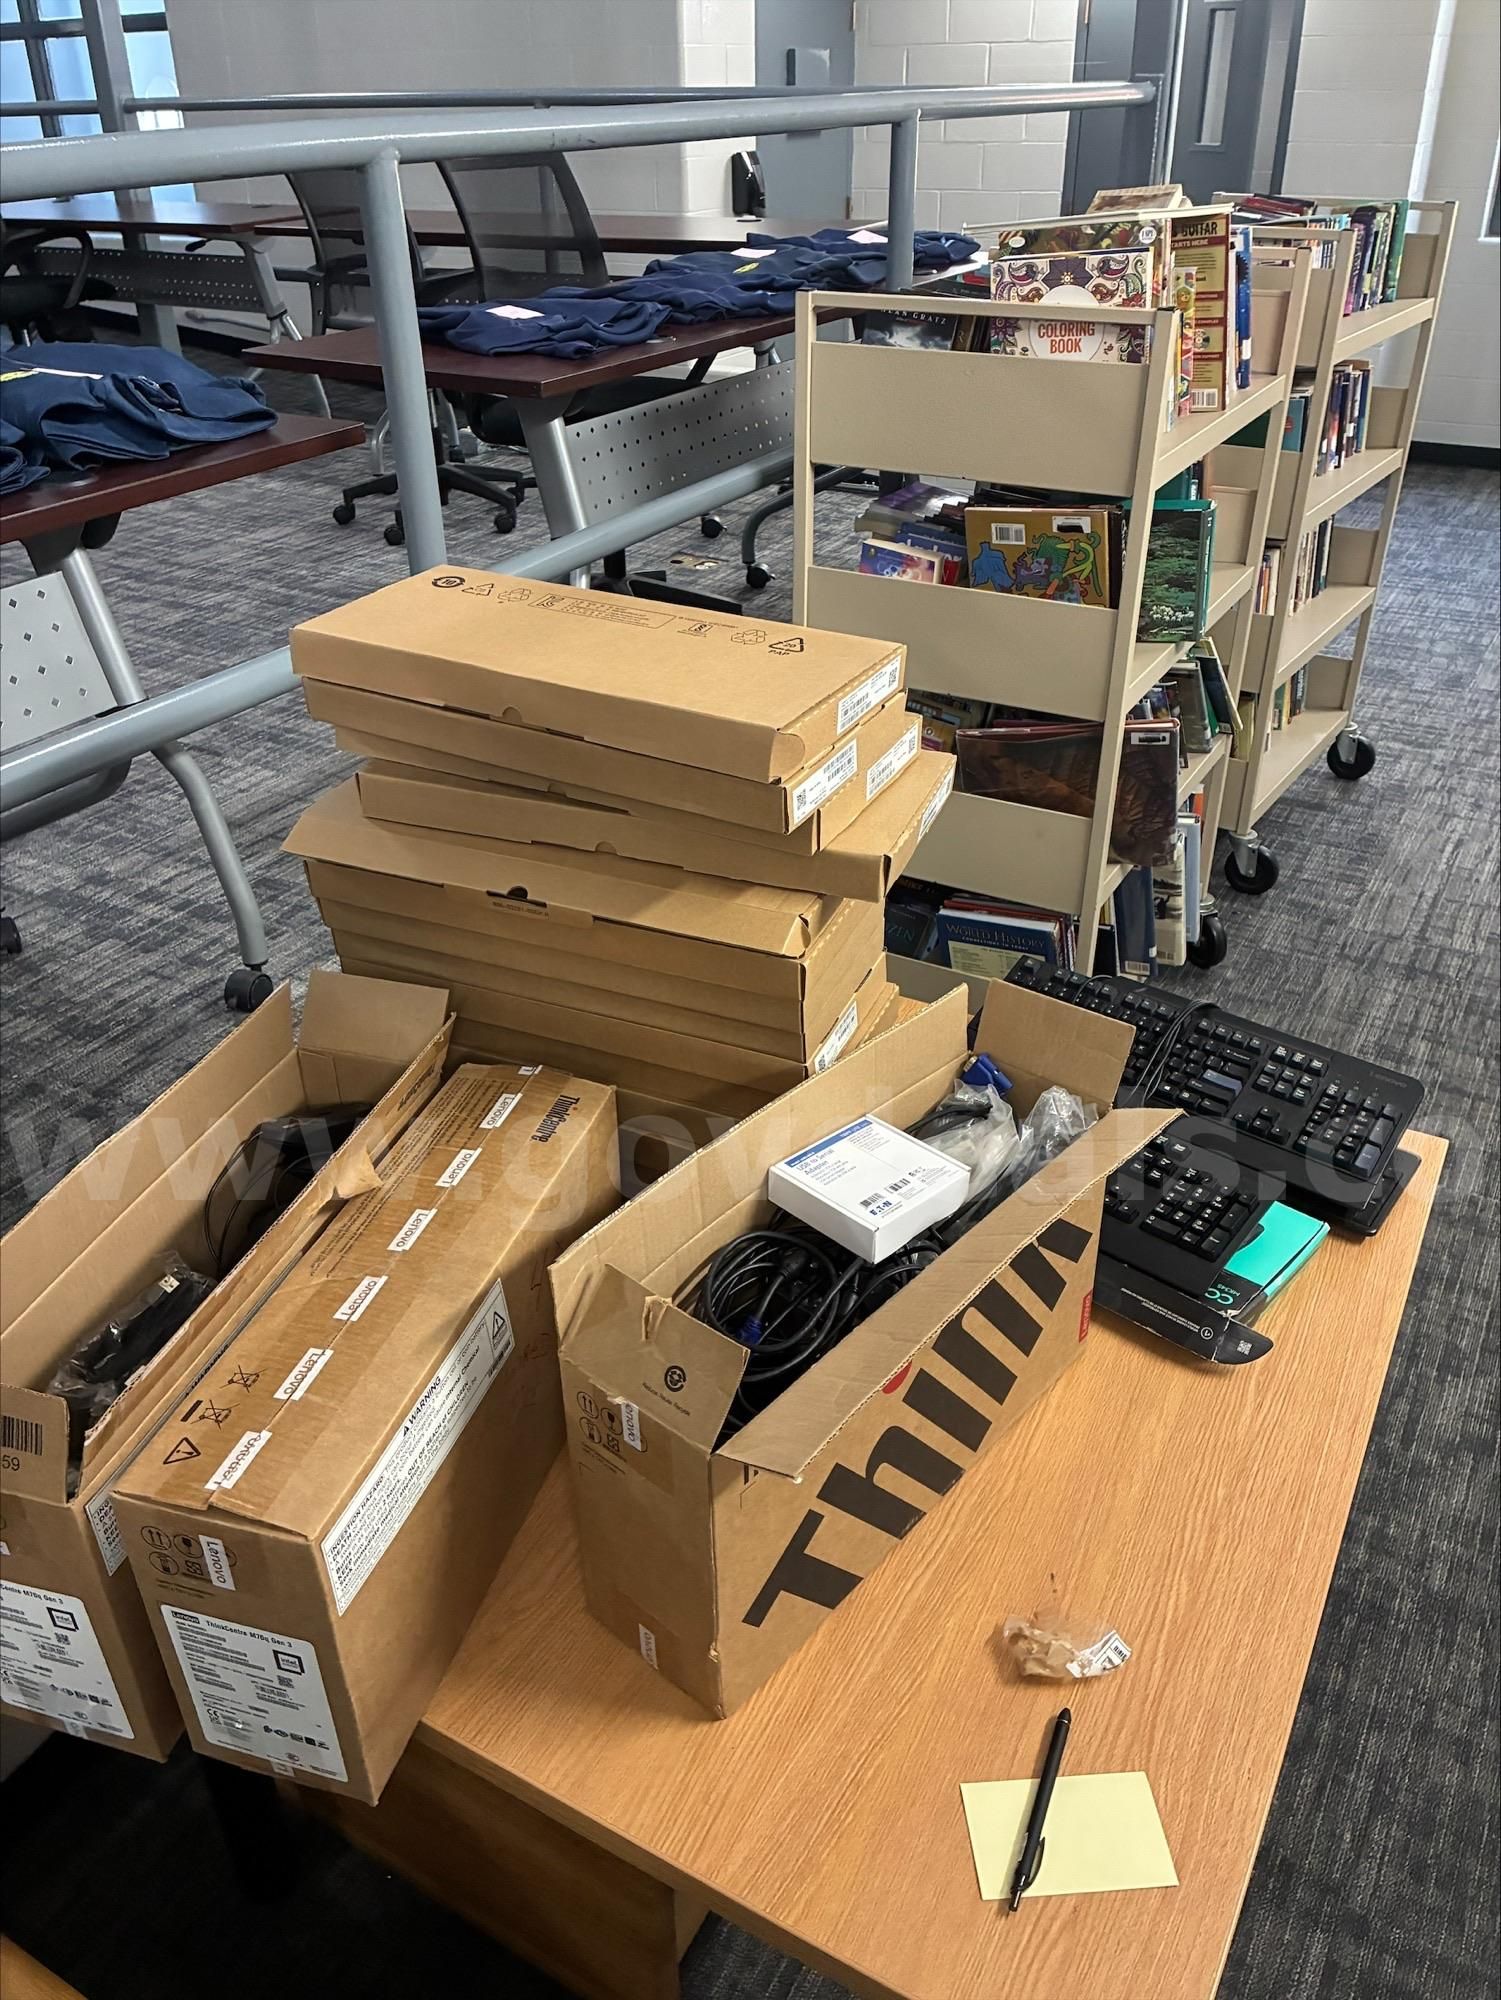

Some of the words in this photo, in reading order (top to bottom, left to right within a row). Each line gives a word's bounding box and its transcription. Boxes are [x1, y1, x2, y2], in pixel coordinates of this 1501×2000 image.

[1182, 221, 1218, 237] GUITAR
[911, 312, 947, 325] GRATZ
[1038, 321, 1096, 338] COLORING
[1049, 338, 1082, 354] BOOK
[767, 649, 790, 657] PAP
[487, 1095, 516, 1126] Lenovo
[531, 1094, 581, 1143] ThinkCentre
[443, 1153, 473, 1186] Lenovo
[395, 1212, 429, 1248] Lenovo
[341, 1278, 378, 1317] Lenovo
[283, 1351, 320, 1396] Lenovo
[460, 1343, 480, 1376] Chemical
[408, 1373, 441, 1427] WARNING
[624, 1403, 636, 1442] enovo
[1, 1454, 21, 1472] 59
[337, 1555, 353, 1582] KEEP
[406, 1456, 418, 1477] OUT
[425, 1421, 441, 1448] REACH
[446, 1378, 469, 1417] CHILDREN
[330, 1507, 361, 1556] INGESTION
[338, 1564, 353, 1588] Seek
[352, 1523, 380, 1568] immediate
[379, 1494, 399, 1527] medical
[398, 1462, 420, 1499] attention
[206, 1540, 227, 1584] Lenovo
[331, 1529, 352, 1563] DEATH
[335, 1547, 352, 1576] Burns
[205, 1620, 247, 1637] ThinkCentre
[248, 1630, 270, 1643] M70q
[269, 1636, 286, 1647] Gen
